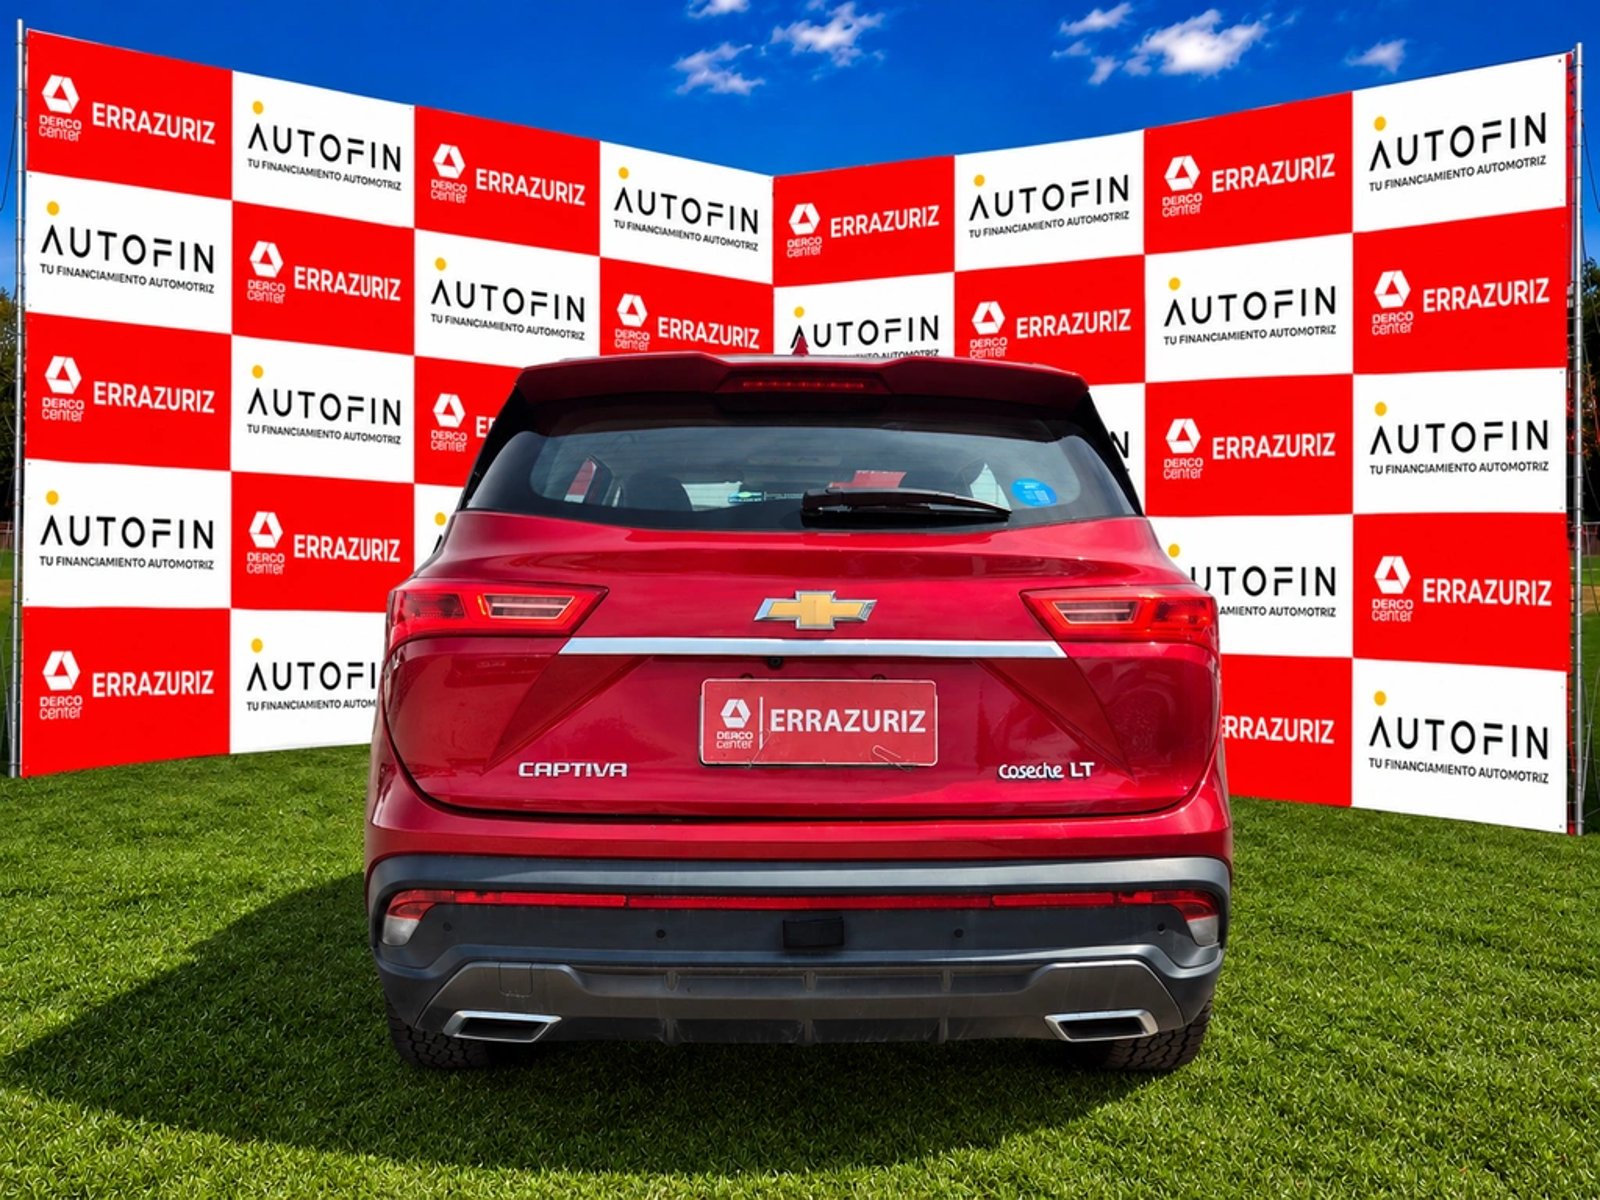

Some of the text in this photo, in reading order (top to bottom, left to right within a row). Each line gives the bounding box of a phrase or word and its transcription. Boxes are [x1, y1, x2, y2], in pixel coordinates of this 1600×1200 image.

[39, 114, 81, 130] DERCO
[92, 101, 214, 144] ERRAZURIZ
[247, 123, 400, 172] AUTOFIN
[1369, 111, 1545, 171] AUTOFIN
[247, 158, 401, 191] TU FINANCIAMIENTO AUTOMOTRIZ
[431, 178, 467, 194] DERCO
[1212, 153, 1334, 192] ERRAZURIZ
[1369, 154, 1546, 191] TU FINANCIAMIENTO AUTOMOTRIZ
[476, 168, 585, 205] ERRAZURIZ
[969, 174, 1128, 221] AUTOFIN
[1162, 192, 1202, 207] DERCO
[613, 187, 757, 234] AUTOFIN
[830, 204, 939, 237] ERRAZURIZ
[969, 210, 1129, 238] TU FINANCIAMIENTO AUTOMOTRIZ
[40, 224, 213, 273] AUTOFIN
[613, 219, 758, 251] TU FINANCIAMIENTO AUTOMOTRIZ
[786, 236, 822, 248] DERCO
[39, 263, 214, 294] TU FINANCIAMIENTO AUTOMOTRIZ
[247, 279, 285, 292] DERCO
[294, 265, 400, 301] ERRAZURIZ
[430, 279, 584, 322] AUTOFIN
[1164, 285, 1335, 326] AUTOFIN
[1423, 277, 1549, 312] ERRAZURIZ
[430, 313, 584, 340] TU FINANCIAMIENTO AUTOMOTRIZ
[1016, 308, 1131, 338] ERRAZURIZ
[1372, 310, 1413, 324] DERCO
[615, 328, 650, 341] DERCO
[657, 316, 760, 349] ERRAZURIZ
[790, 315, 938, 348] AUTOFIN
[969, 336, 1007, 348] DERCO
[1163, 324, 1336, 345] TU FINANCIAMIENTO AUTOMOTRIZ
[41, 396, 84, 410] DERCO
[93, 381, 214, 413] ERRAZURIZ
[247, 387, 400, 426] AUTOFIN
[247, 423, 400, 444] TU FINANCIAMIENTO AUTOMOTRIZ
[430, 429, 467, 441] DERCO
[1212, 432, 1335, 459] ERRAZURIZ
[1369, 419, 1547, 454] AUTOFIN
[1163, 457, 1203, 468] DERCO
[1369, 460, 1548, 475] TU FINANCIAMIENTO AUTOMOTRIZ
[40, 514, 213, 549] AUTOFIN
[246, 551, 284, 563] DERCO
[294, 534, 400, 562] ERRAZURIZ
[39, 555, 213, 570] TU FINANCIAMIENTO AUTOMOTRIZ
[1191, 566, 1335, 596] UTOFIN
[1422, 578, 1551, 605] ERRAZURIZ
[1269, 607, 1336, 617] AUTOMOTRIZ
[1372, 598, 1413, 610] DERCO
[92, 670, 213, 697] ERRAZURIZ
[247, 661, 375, 691] AUTOFI
[39, 695, 82, 707] DERCO
[247, 699, 376, 711] TU FINANCIAMIENTO AUTOM
[770, 709, 926, 733] ERRAZURIZ
[716, 731, 753, 740] DERCO
[1369, 715, 1547, 759] AUTOFIN
[518, 762, 628, 777] CAPTIVA
[1070, 762, 1095, 777] LT
[1368, 757, 1548, 783] TU FINANCIAMIENTO AUTOMOTRIZ
